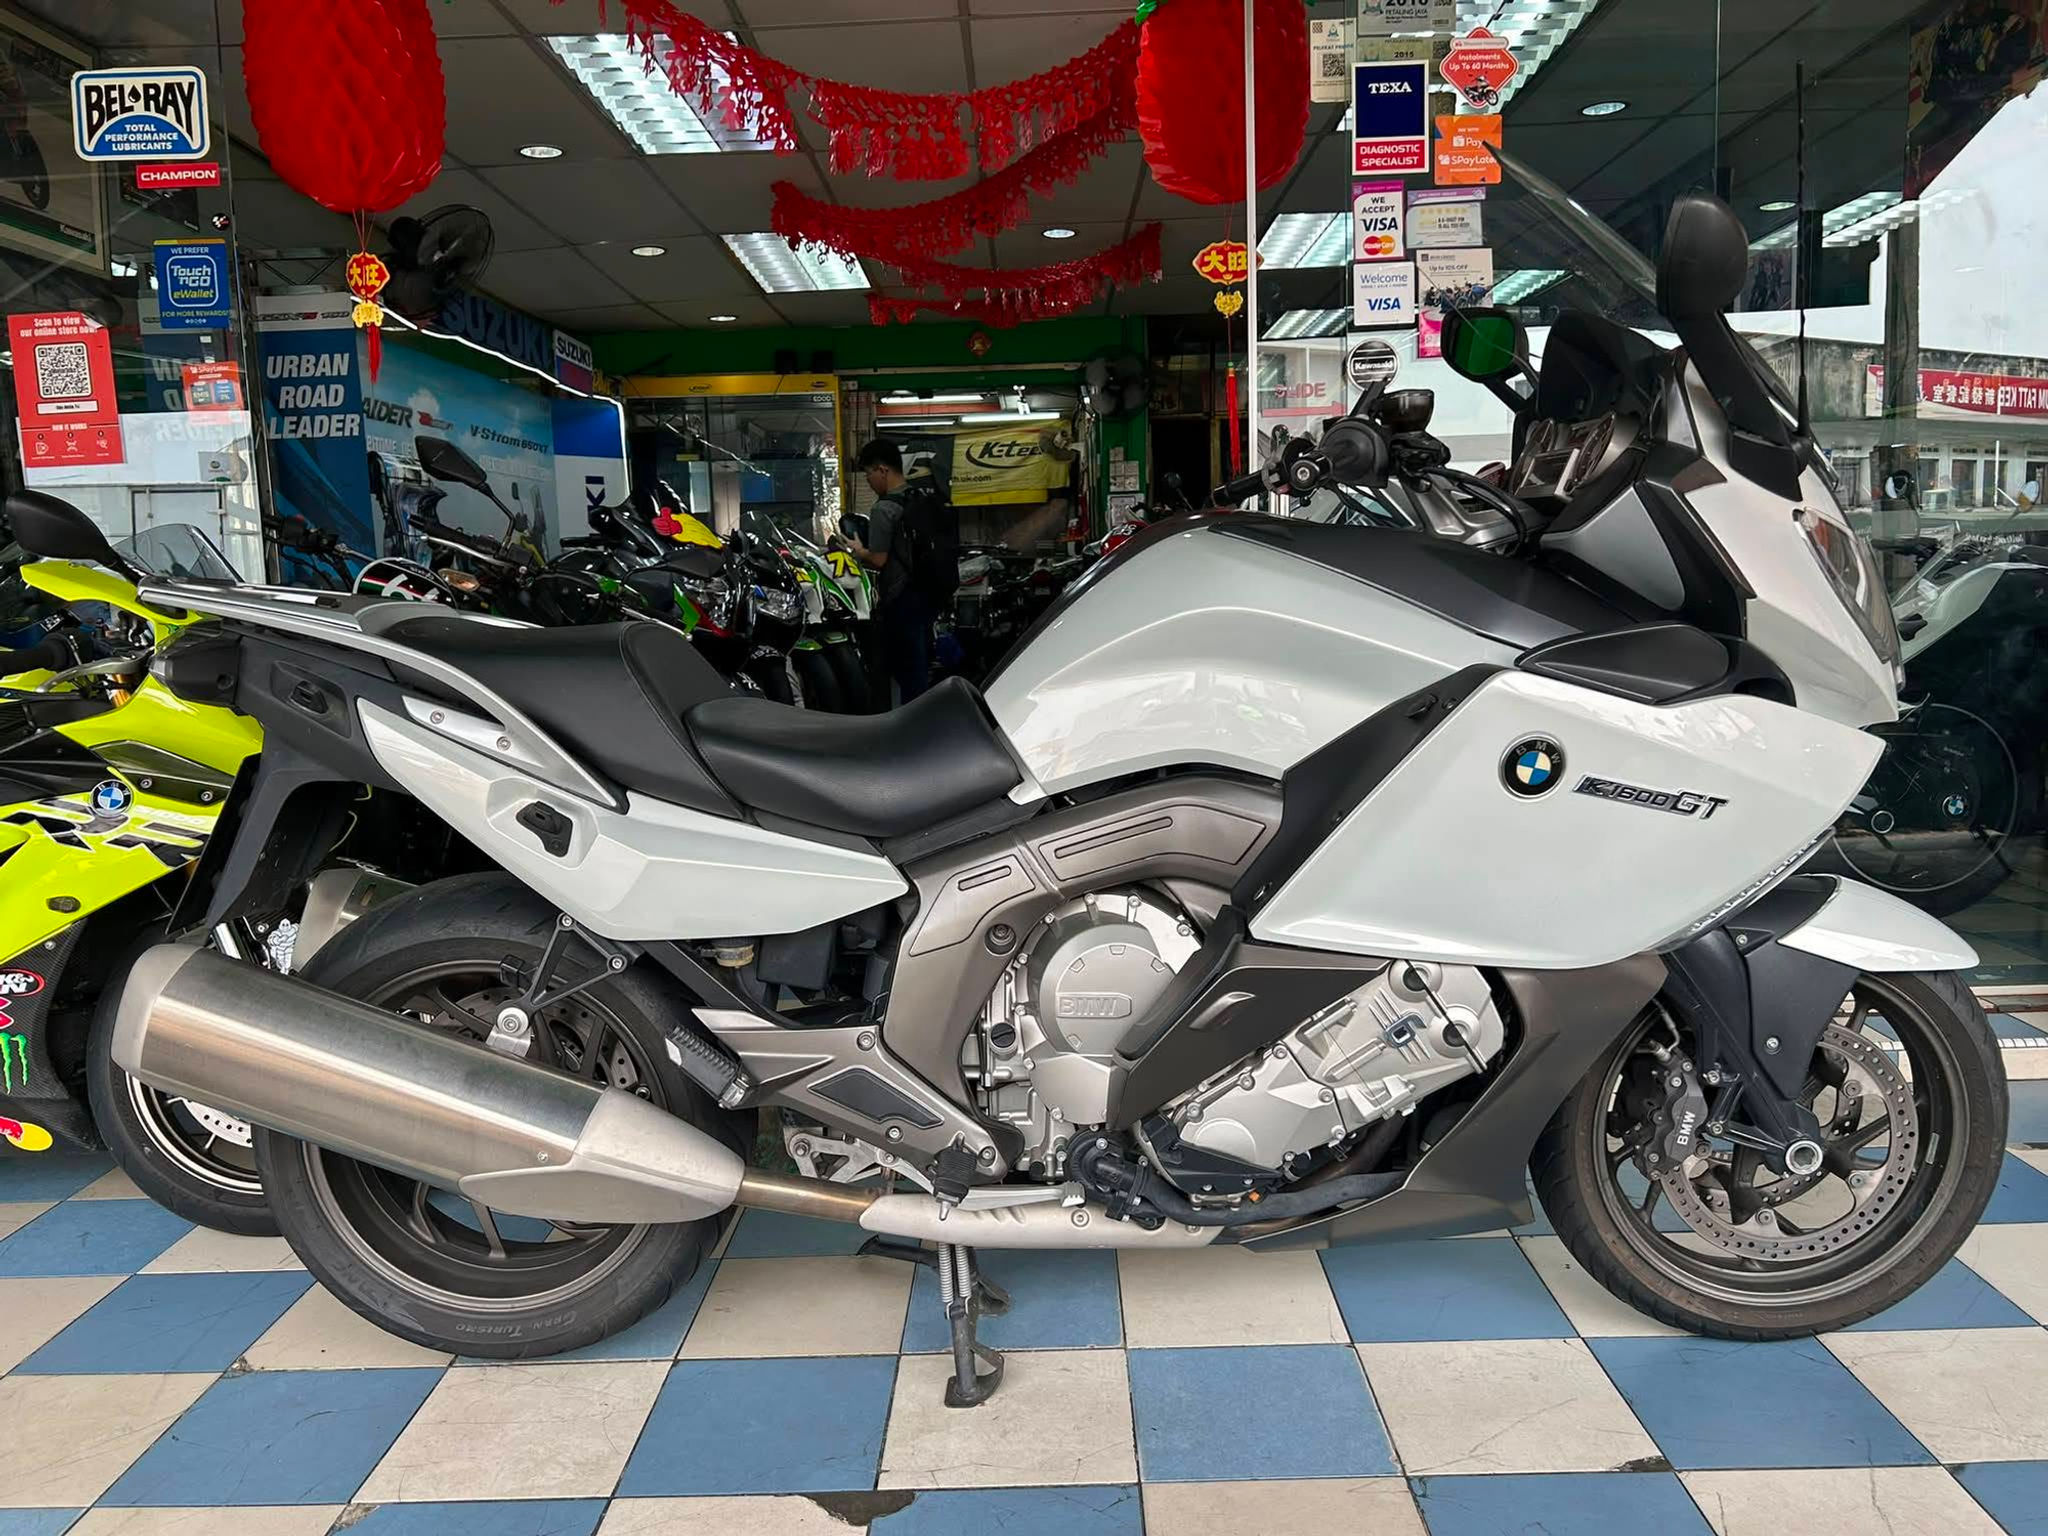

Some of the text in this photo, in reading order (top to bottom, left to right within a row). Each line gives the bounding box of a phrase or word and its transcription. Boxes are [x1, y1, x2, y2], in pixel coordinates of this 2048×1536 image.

[1458, 53, 1500, 61] Instalments
[1449, 62, 1510, 71] Up To 60 Months
[1368, 82, 1412, 94] TEXA
[125, 124, 156, 132] TOTAL
[105, 132, 178, 142] PERFORMANCE
[112, 142, 172, 151] LUBRICANTS
[1360, 144, 1420, 155] DIAGNOSTIC
[1361, 156, 1419, 167] SPECIALIST
[140, 170, 216, 181] CHAMPION
[1371, 196, 1386, 204] WE
[1362, 205, 1396, 214] ACCEPT
[1360, 217, 1398, 231] VISA
[183, 246, 209, 254] PREFER
[1203, 251, 1247, 272] 大旺
[171, 264, 211, 277] Touch
[350, 263, 381, 287] 大旺
[1360, 273, 1408, 284] Welcome
[173, 288, 214, 299] eWallet
[1365, 297, 1401, 311] VISA
[34, 316, 80, 327] Scan to view
[20, 329, 32, 337] our
[34, 327, 57, 336] online
[58, 326, 78, 335] store
[443, 298, 549, 370] SUZUKI
[555, 336, 592, 368] SUZUKI
[266, 352, 350, 379] URBAN
[279, 384, 345, 409] ROAD
[1274, 383, 1326, 399] SLIDE
[269, 413, 361, 440] LEADER
[1515, 741, 1562, 765] BMW
[1060, 999, 1117, 1016] BMW
[1676, 1110, 1696, 1145] BMW
